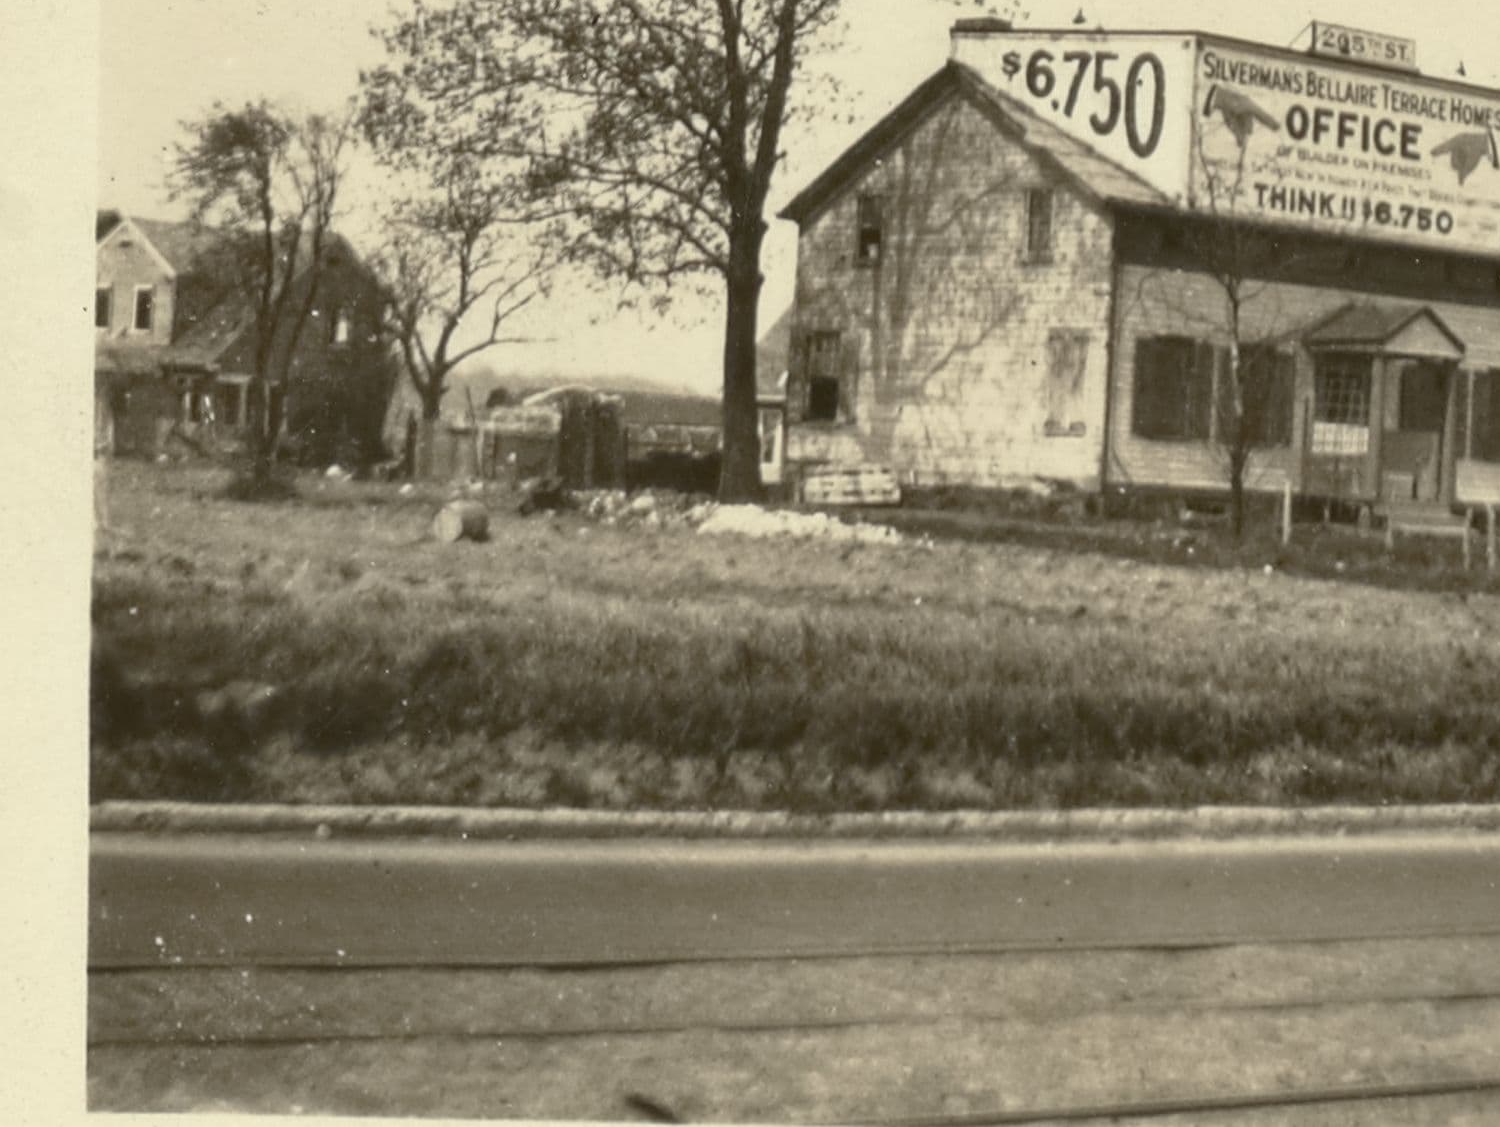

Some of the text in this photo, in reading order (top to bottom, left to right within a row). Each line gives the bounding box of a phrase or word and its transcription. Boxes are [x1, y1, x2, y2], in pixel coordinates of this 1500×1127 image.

[1001, 49, 1166, 159] $6.750
[1306, 71, 1378, 109] BELLAIRE
[1381, 84, 1447, 122] TERRACE
[1285, 105, 1423, 161] OFFICE
[1254, 182, 1335, 219] THINK
